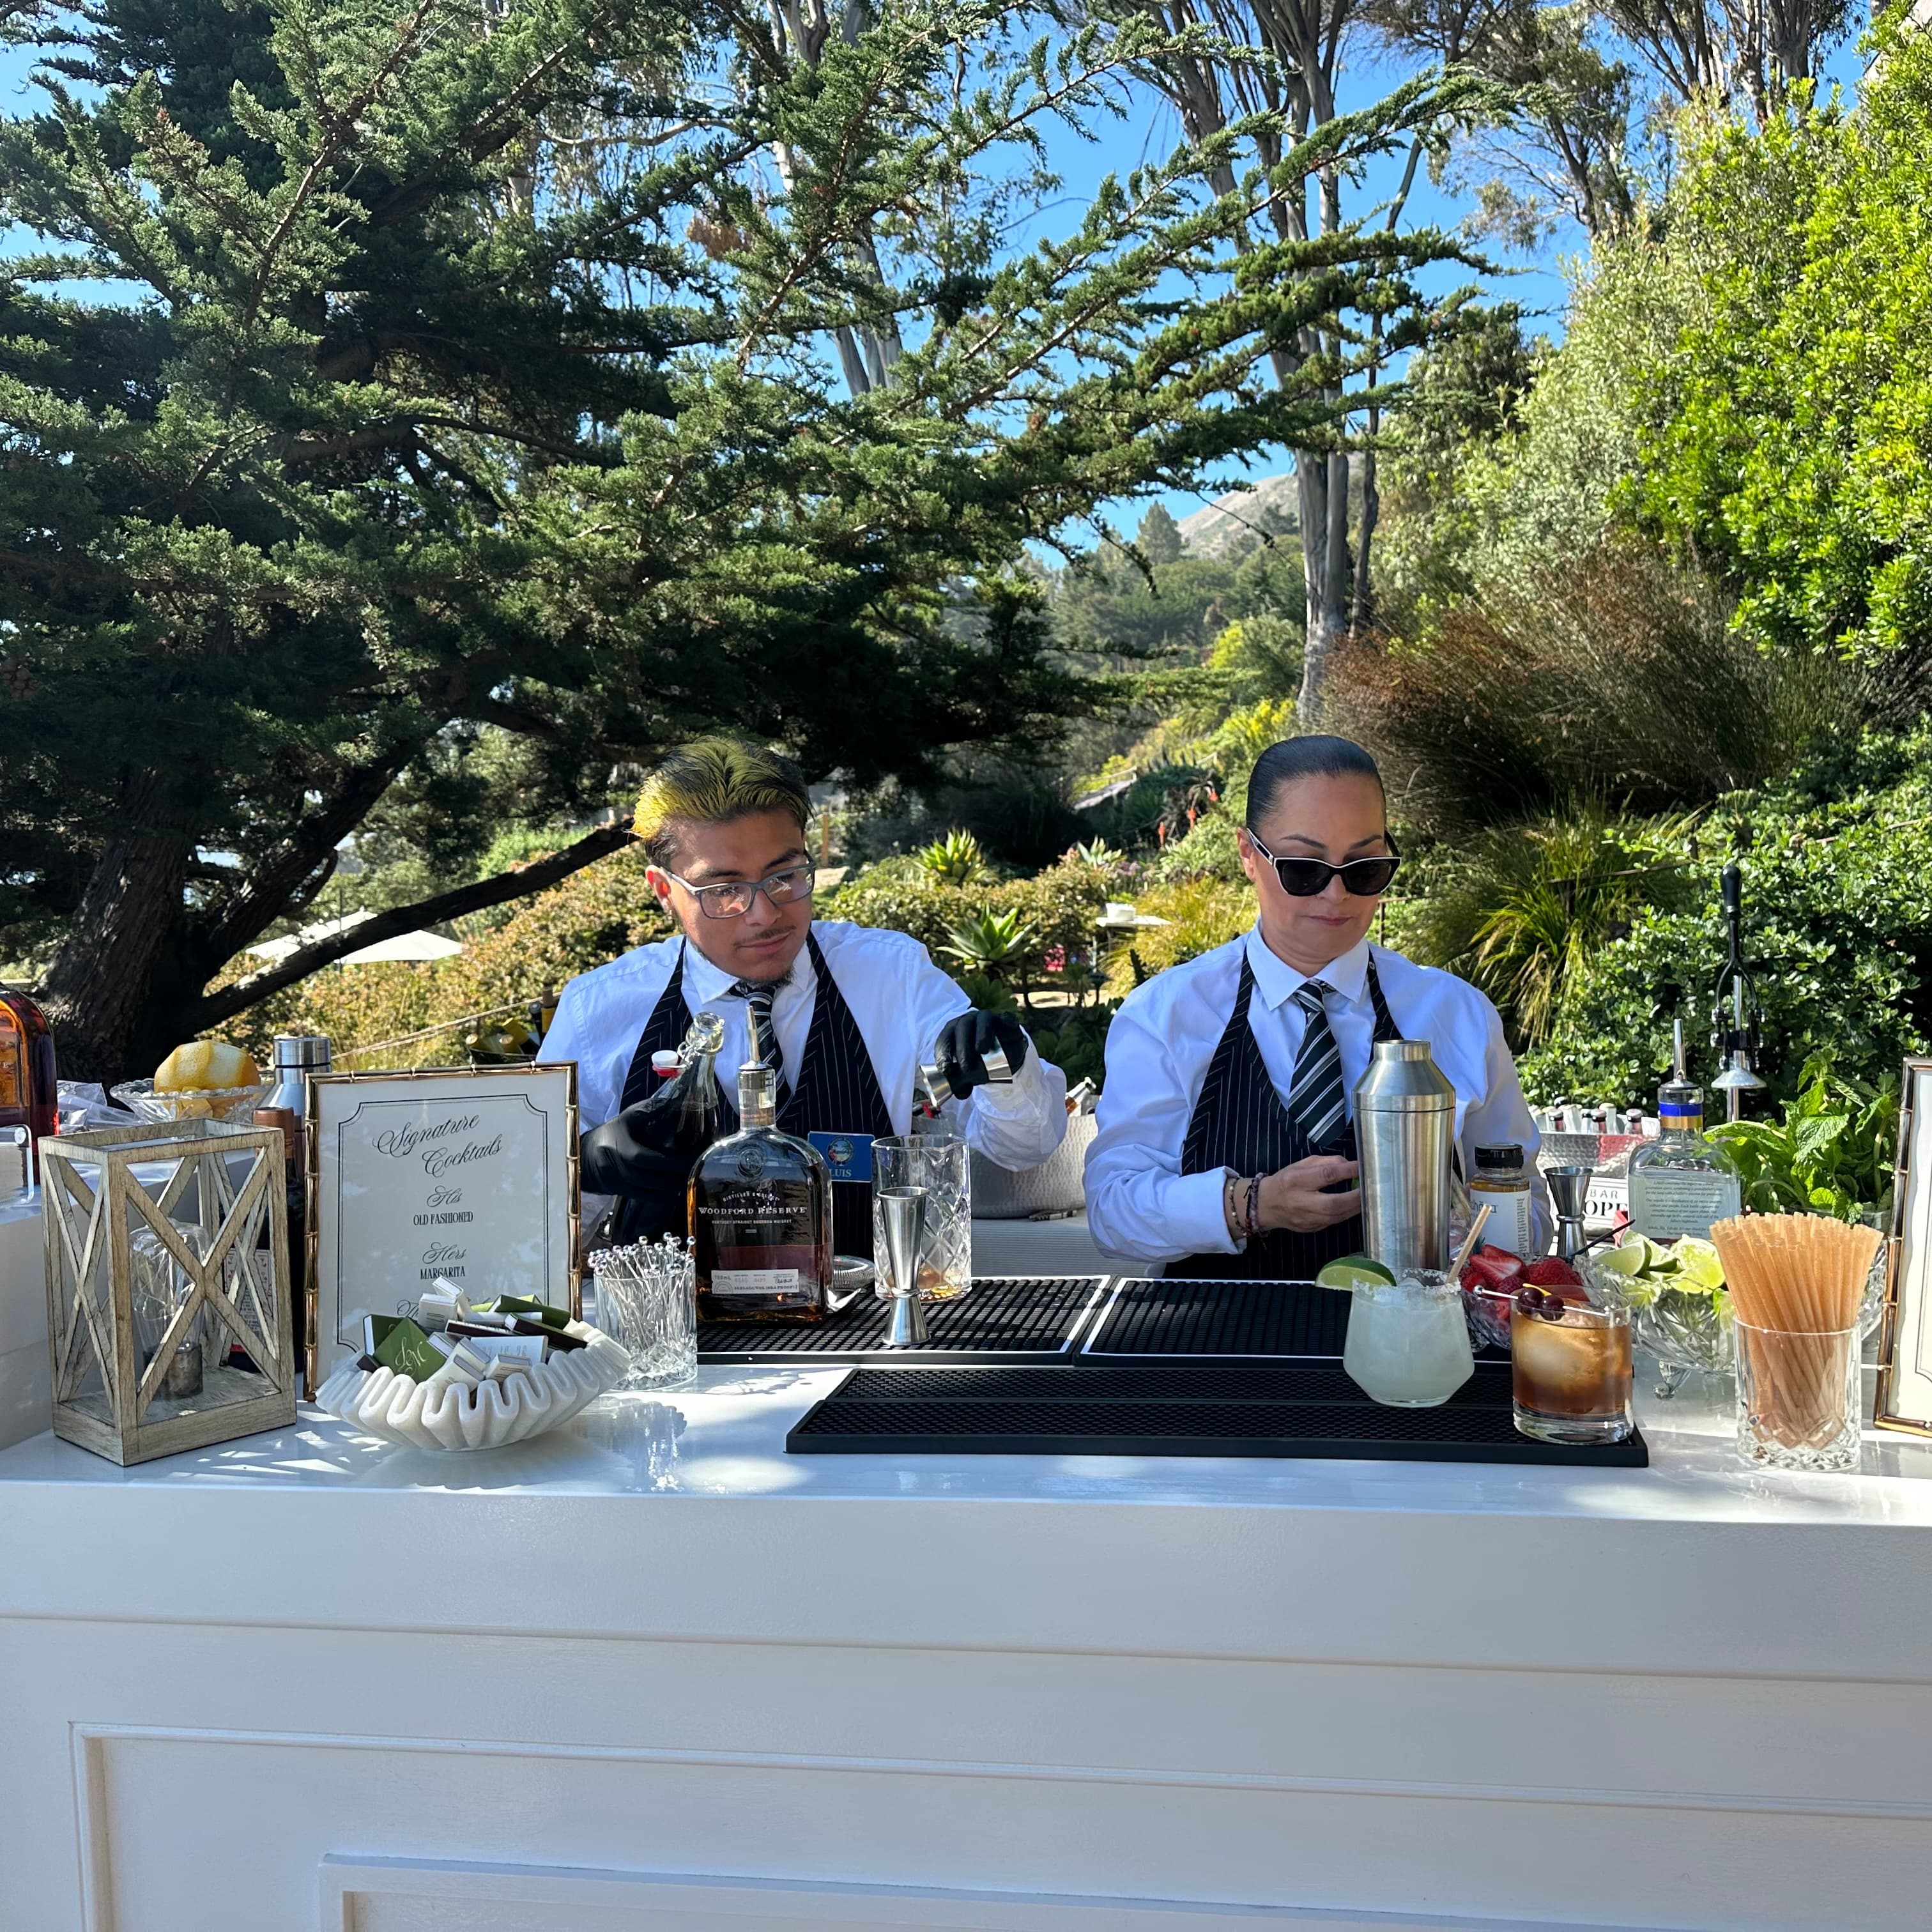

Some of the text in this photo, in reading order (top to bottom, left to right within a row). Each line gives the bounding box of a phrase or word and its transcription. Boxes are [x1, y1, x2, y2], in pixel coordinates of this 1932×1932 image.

[372, 1114, 479, 1158] Signature
[422, 1133, 502, 1177] Cocktails
[830, 1169, 852, 1177] LUIS
[426, 1185, 463, 1208] His
[1590, 1188, 1618, 1199] BAR
[758, 1206, 807, 1215] RESERVE
[413, 1211, 473, 1225] OLD FASHIONED
[422, 1241, 466, 1264] Hers
[420, 1266, 466, 1280] MARGARITA
